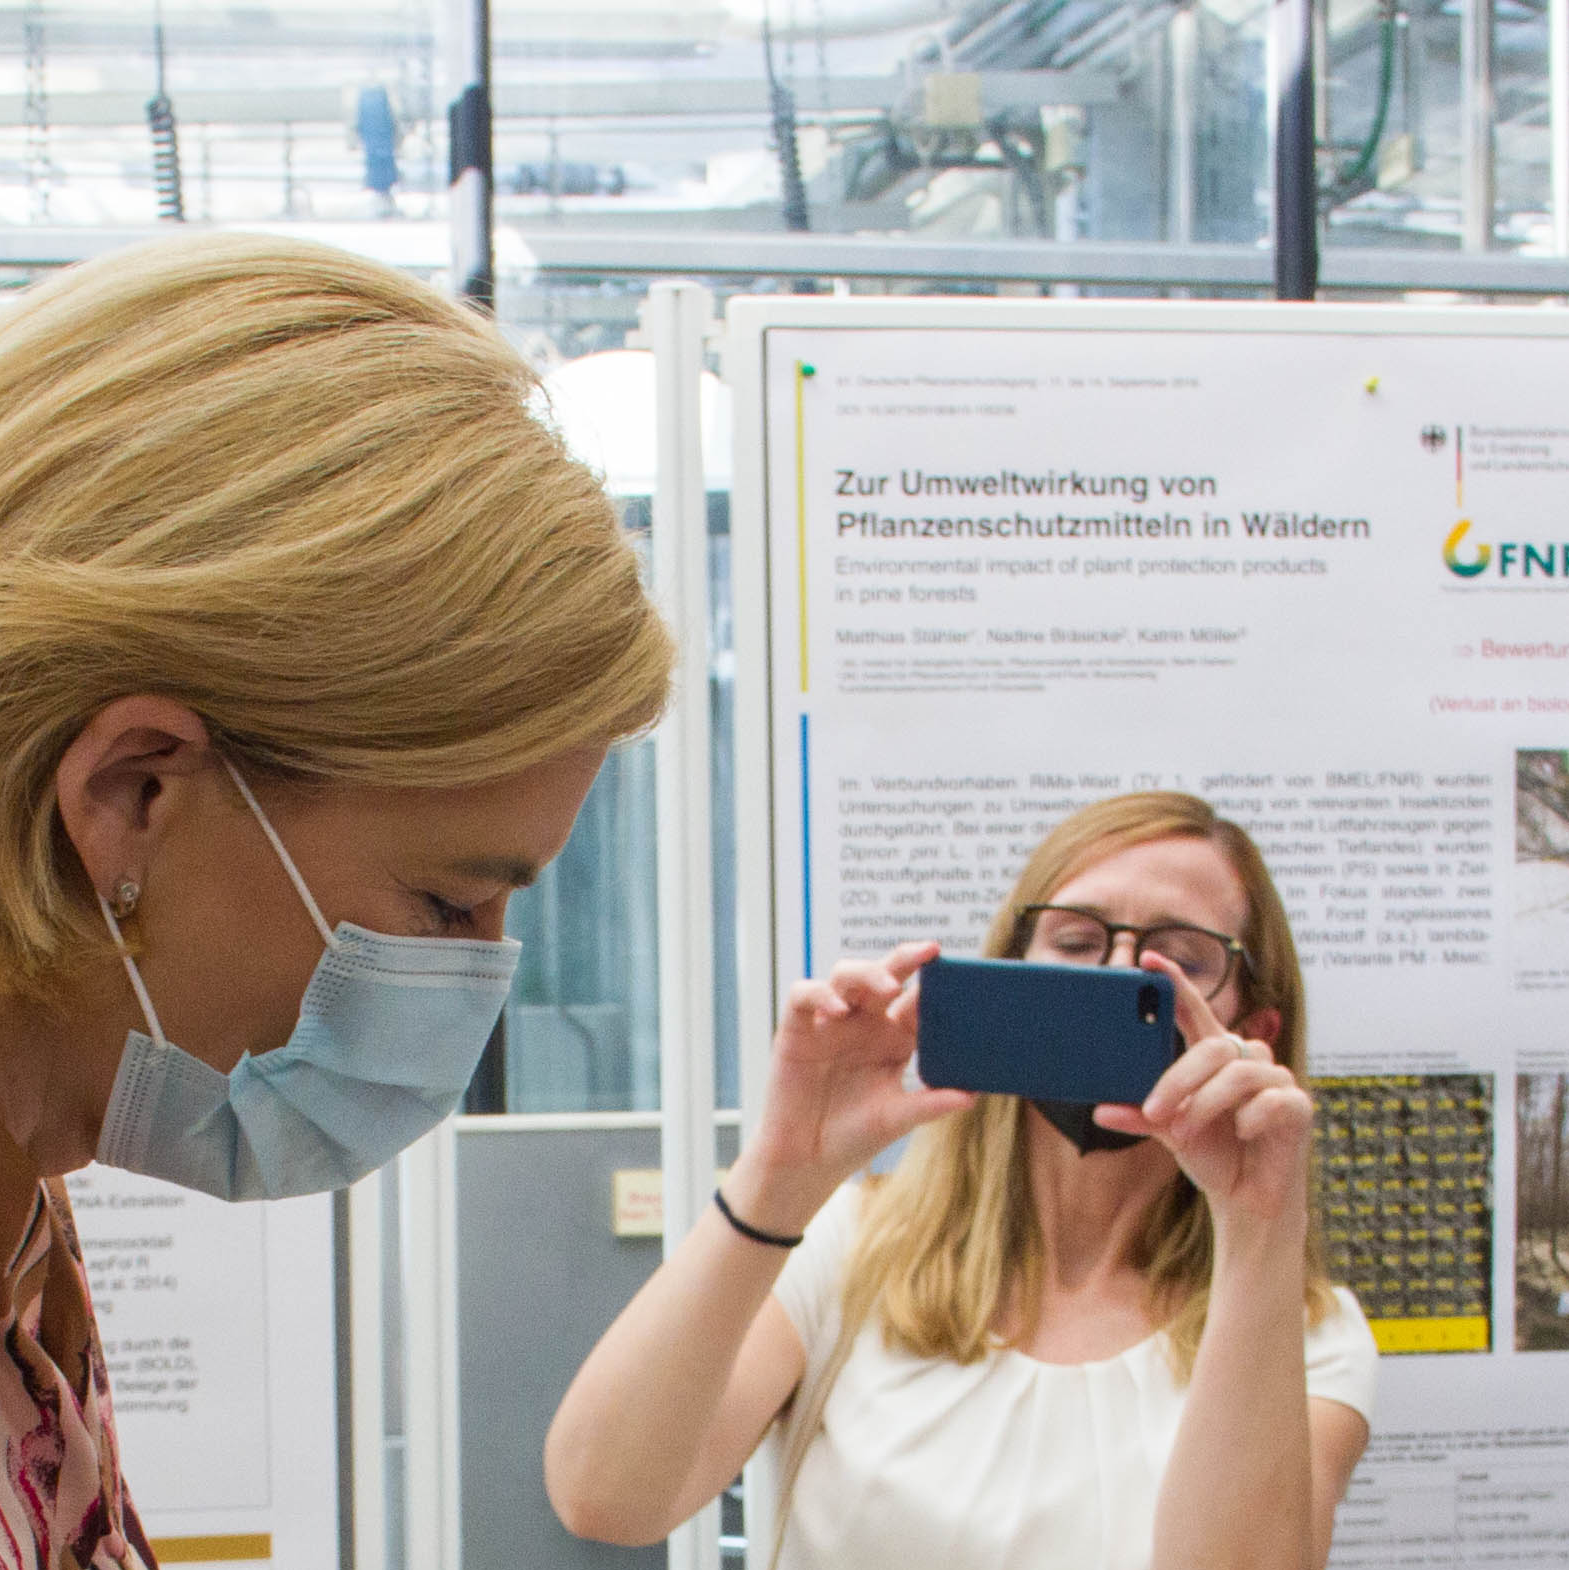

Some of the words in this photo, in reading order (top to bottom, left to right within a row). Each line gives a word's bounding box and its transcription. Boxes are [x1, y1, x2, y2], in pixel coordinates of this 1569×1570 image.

[836, 470, 888, 496] Zur
[901, 471, 1148, 503] Umweltwirkung
[1160, 476, 1216, 496] von
[838, 512, 1191, 537] Pflanzenschutzmitteln
[1203, 513, 1230, 537] in
[1242, 513, 1370, 538] Wäldern
[835, 556, 981, 575] Environmental
[986, 558, 1053, 577] impact
[1058, 556, 1078, 574] of
[1083, 557, 1133, 576] plant
[1138, 558, 1236, 576] protection
[1242, 558, 1328, 576] products
[835, 587, 853, 602] in
[859, 587, 901, 605] pine
[908, 585, 977, 603] forests
[1501, 699, 1522, 711] an
